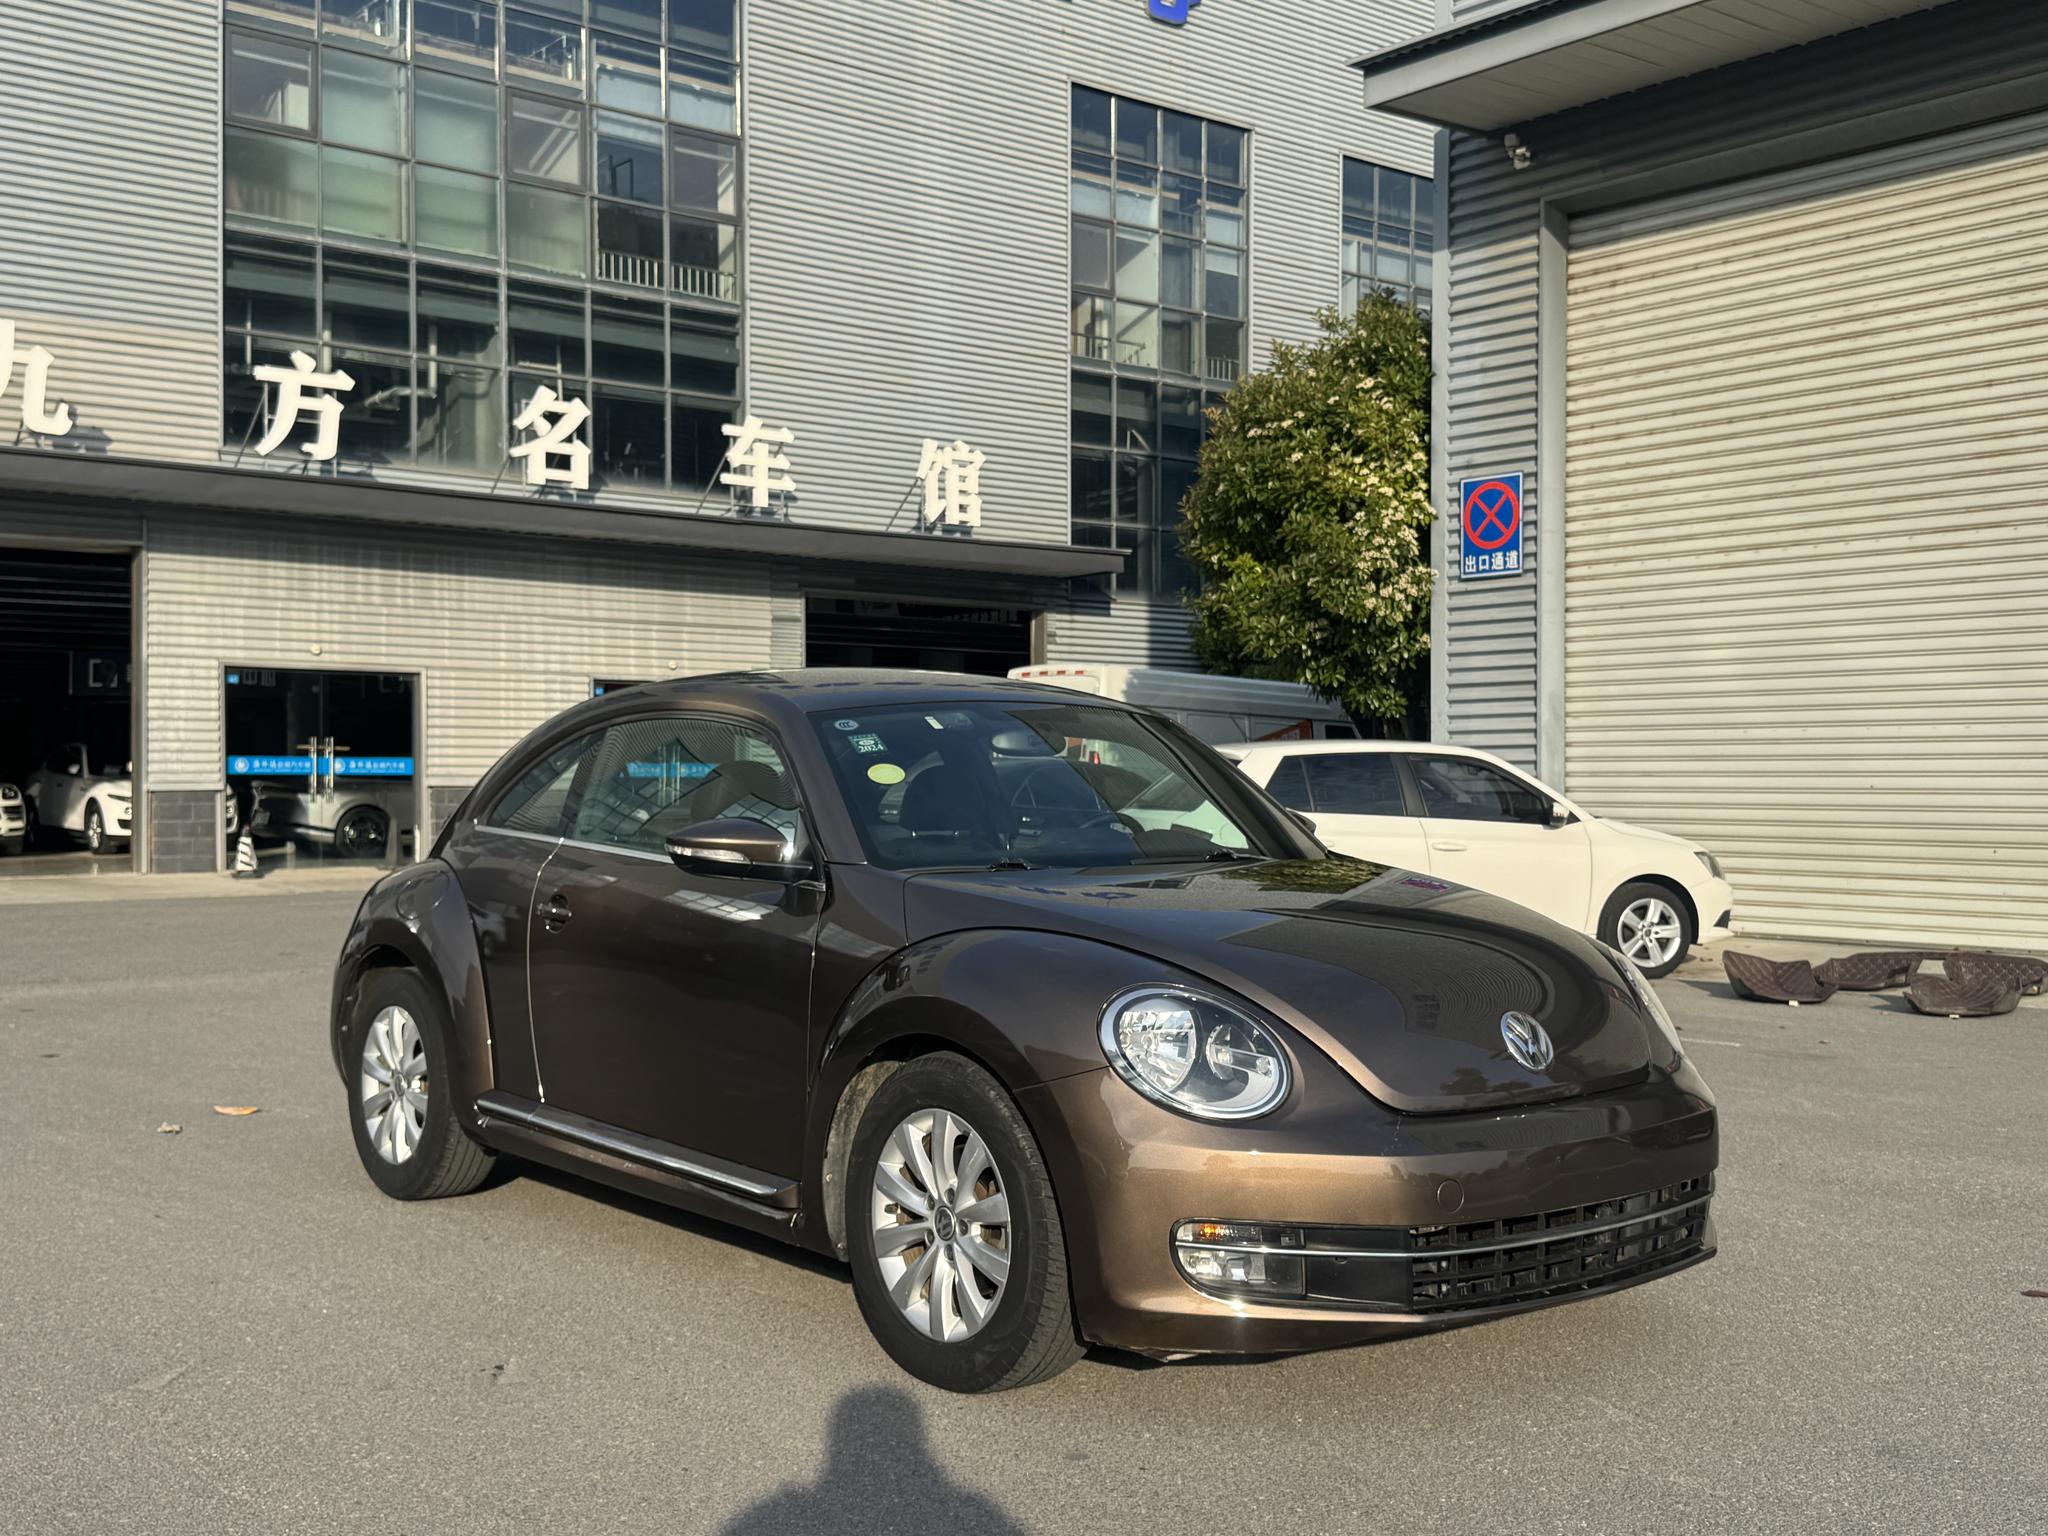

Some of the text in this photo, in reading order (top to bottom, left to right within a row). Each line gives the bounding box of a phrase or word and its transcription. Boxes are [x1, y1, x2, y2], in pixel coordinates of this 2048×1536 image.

[1465, 550, 1519, 573] 出口通道
[858, 744, 884, 753] 2024
